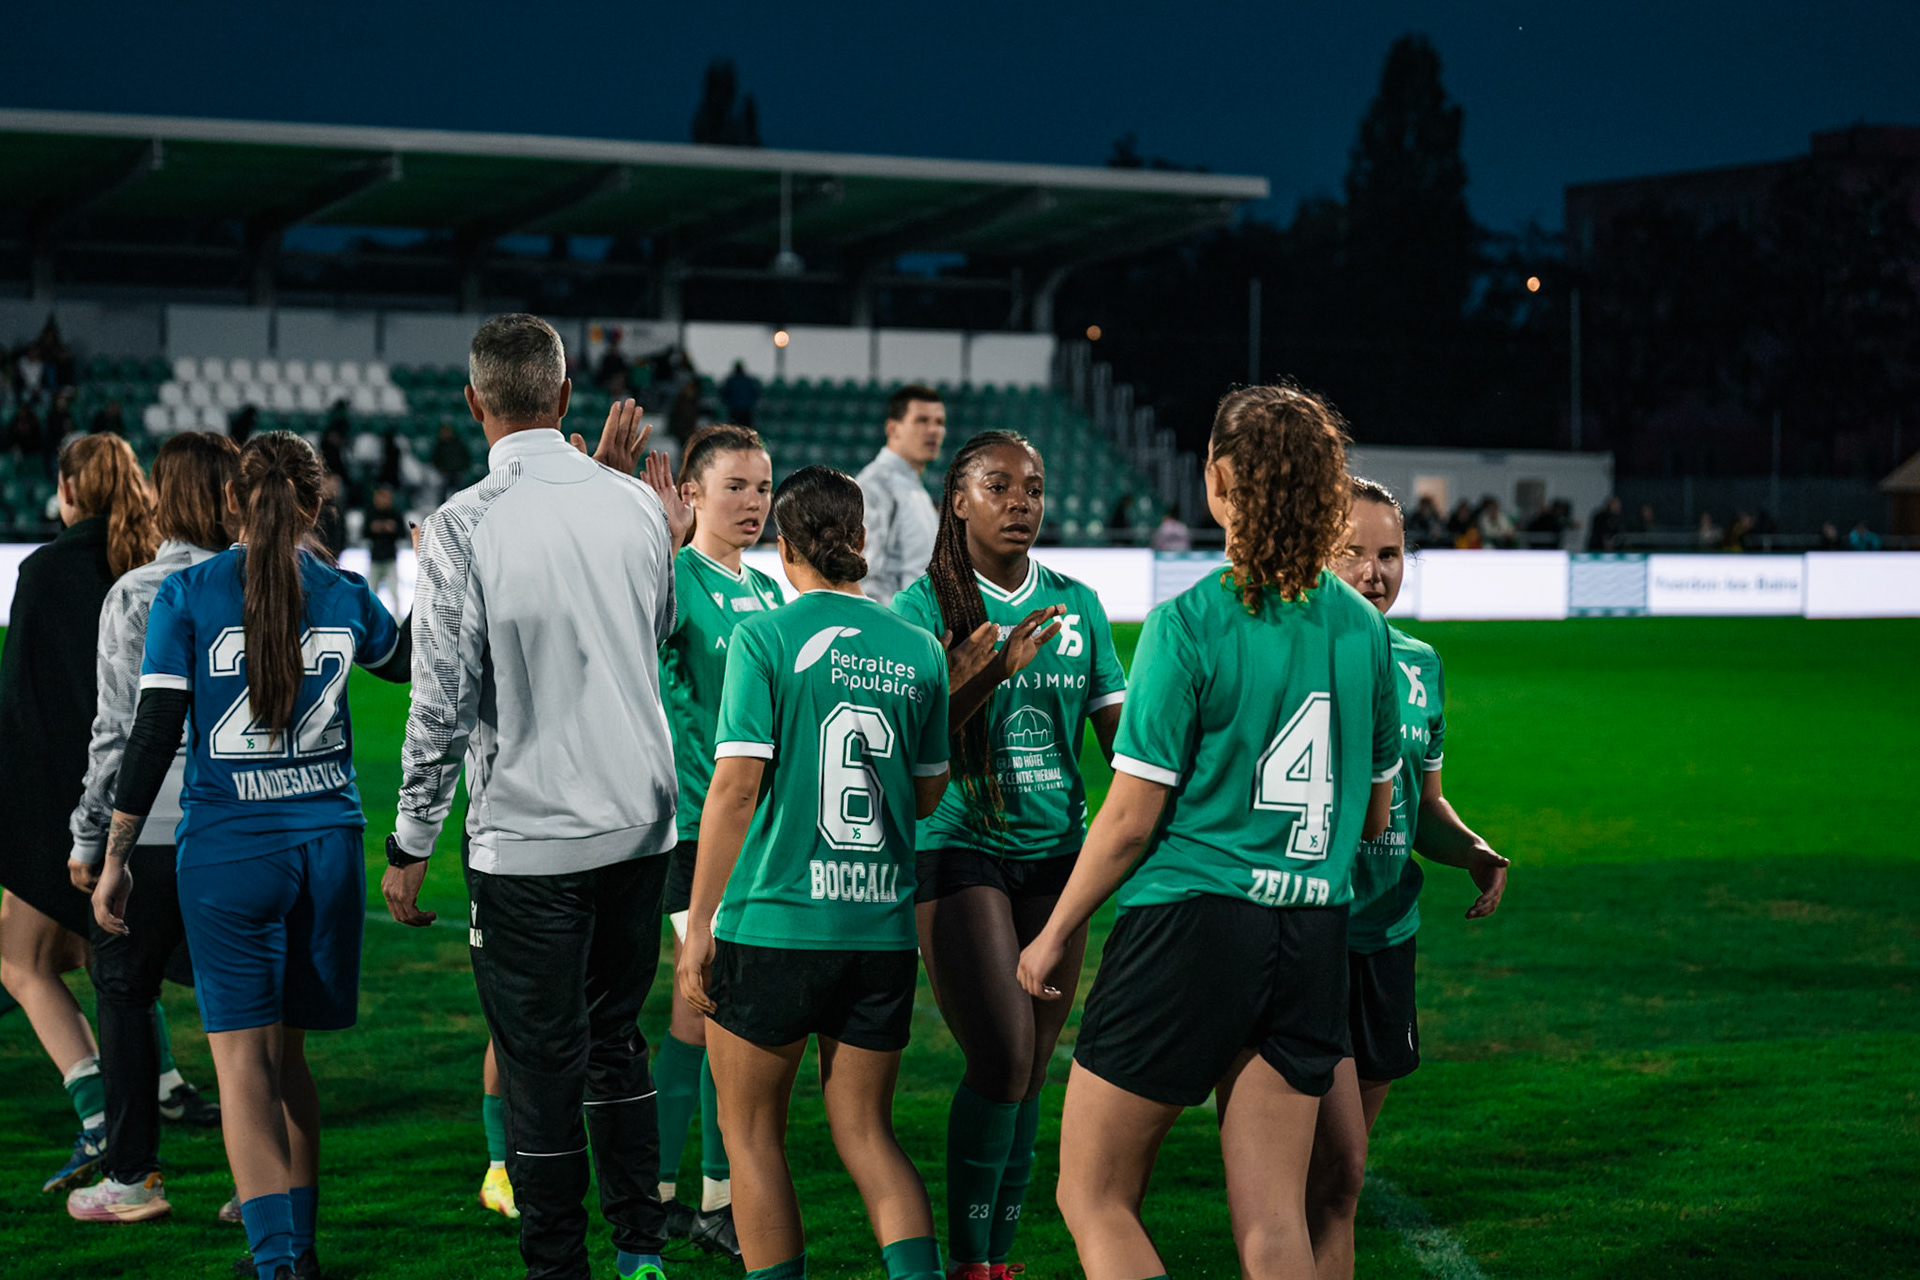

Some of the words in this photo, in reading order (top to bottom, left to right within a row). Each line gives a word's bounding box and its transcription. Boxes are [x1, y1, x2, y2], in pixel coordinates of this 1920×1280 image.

[830, 648, 916, 680] Retraites
[209, 626, 355, 759] 22
[831, 667, 923, 704] Populaires
[817, 701, 895, 852] 6
[996, 756, 1023, 769] GRAND
[1005, 771, 1034, 785] CENTRE
[1253, 691, 1334, 860] 4
[968, 1204, 990, 1219] 23
[1005, 1204, 1021, 1221] 23
